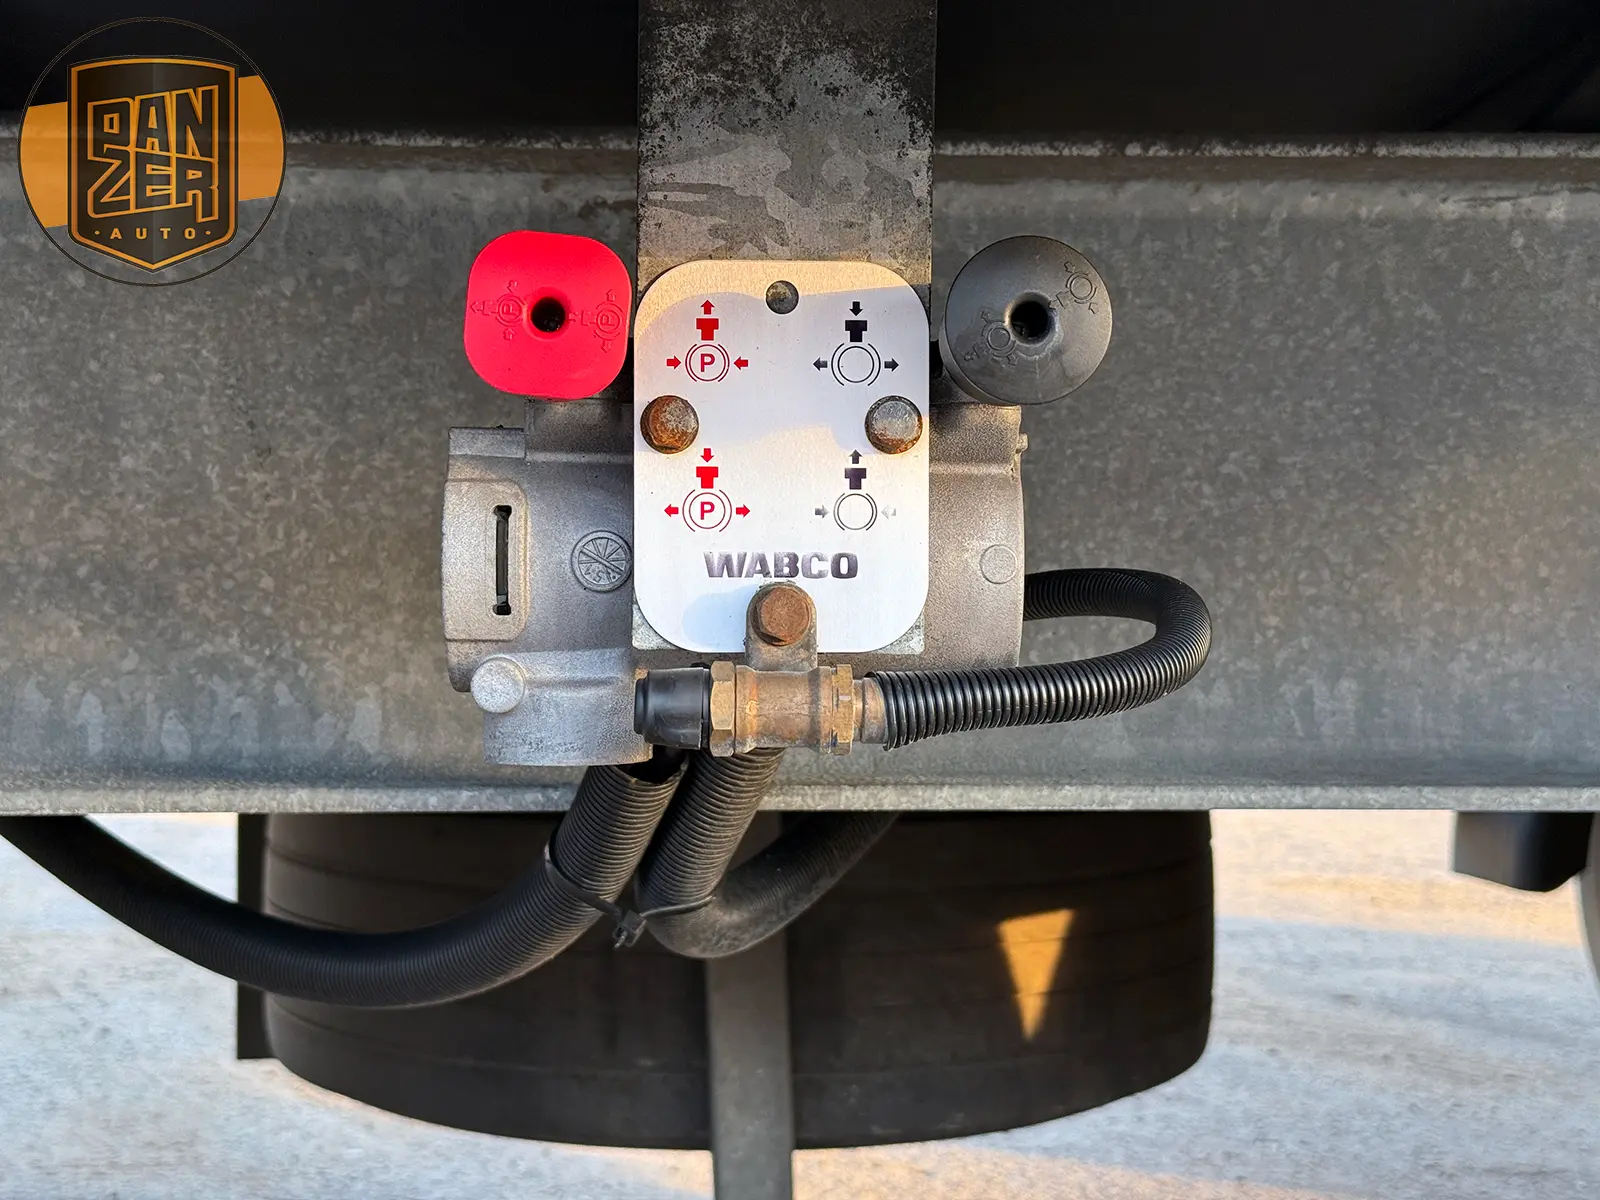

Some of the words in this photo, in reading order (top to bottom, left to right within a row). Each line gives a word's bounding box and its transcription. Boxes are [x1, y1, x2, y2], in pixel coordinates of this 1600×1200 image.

[700, 354, 715, 372] P
[700, 502, 715, 521] P
[703, 551, 859, 579] WABCO
